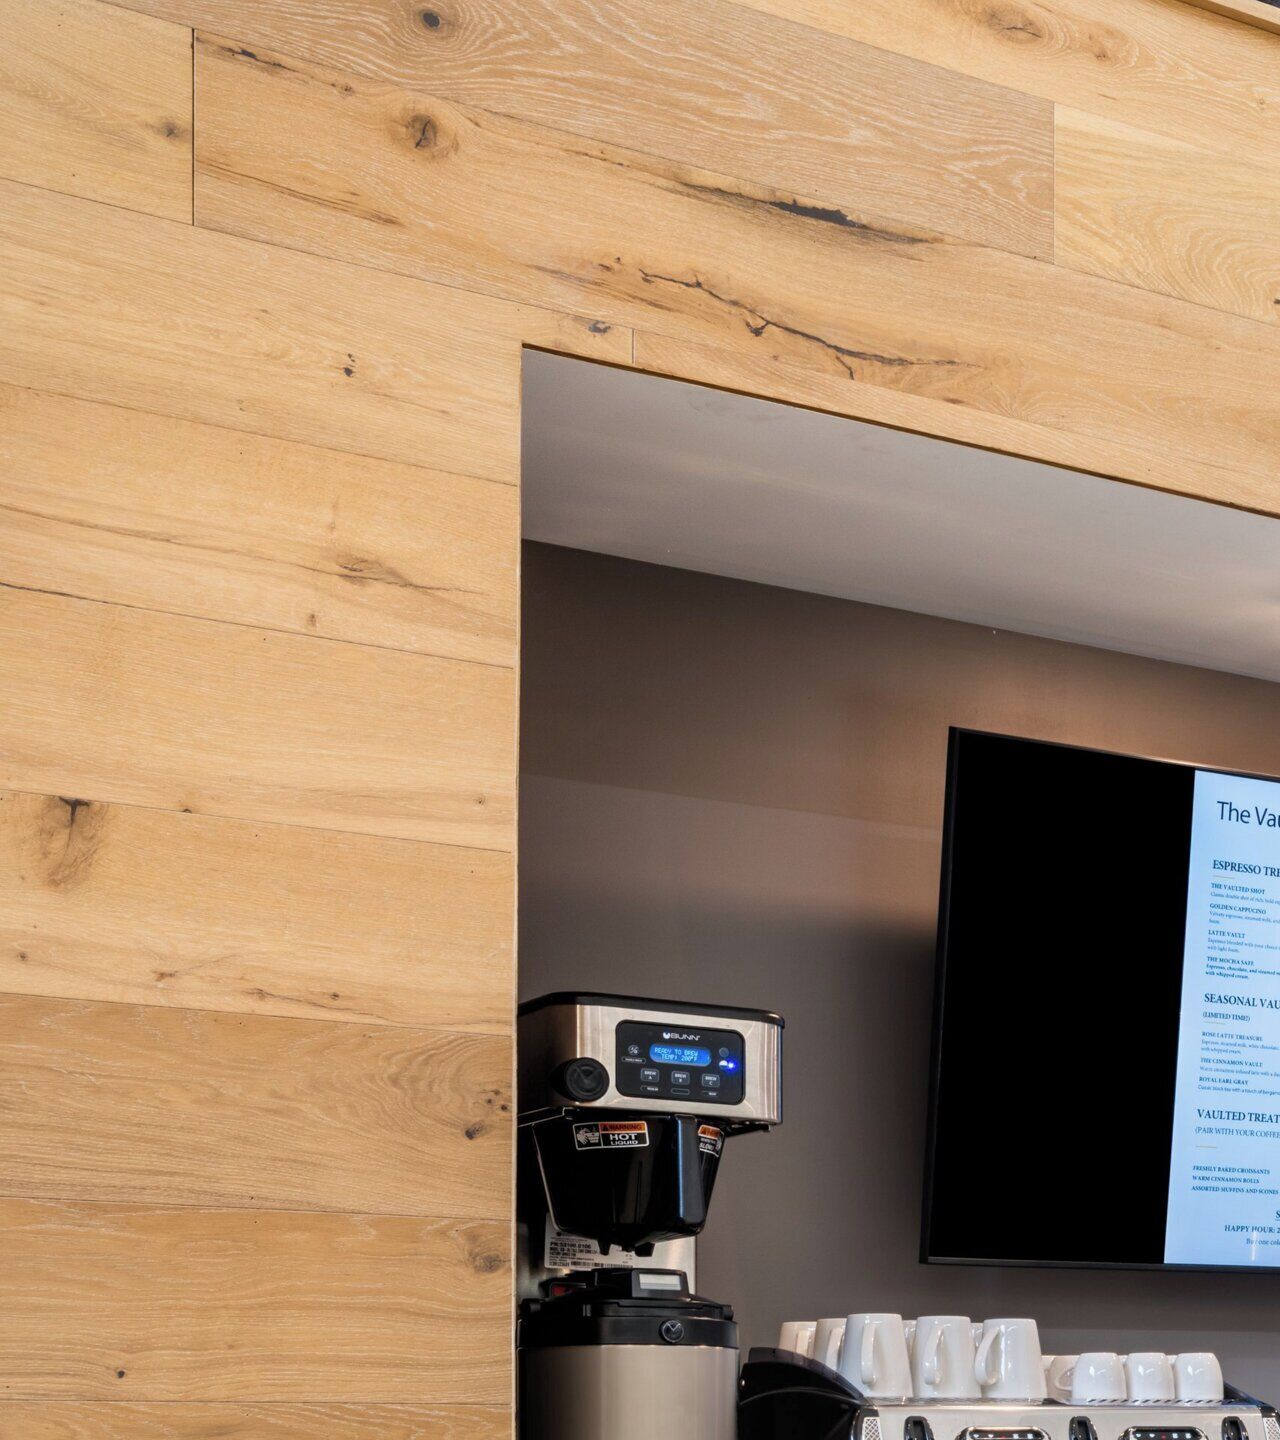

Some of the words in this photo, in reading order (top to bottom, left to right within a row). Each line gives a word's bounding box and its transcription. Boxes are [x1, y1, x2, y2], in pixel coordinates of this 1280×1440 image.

[1217, 800, 1251, 824] The
[1213, 860, 1261, 875] ESPRESSO
[1223, 885, 1249, 893] VAULTED
[1210, 903, 1233, 911] GOLDEN
[1204, 993, 1258, 1007] SEASONAL
[1203, 1011, 1231, 1021] (LIMITED
[670, 1033, 699, 1041] BUNN
[1197, 1109, 1246, 1121] VAULTED
[609, 1133, 638, 1141] HOT
[1195, 1126, 1214, 1135] (PAIR
[1216, 1128, 1234, 1137] WITH
[1235, 1129, 1255, 1138] YOUR
[1225, 1225, 1250, 1233] HAPPY
